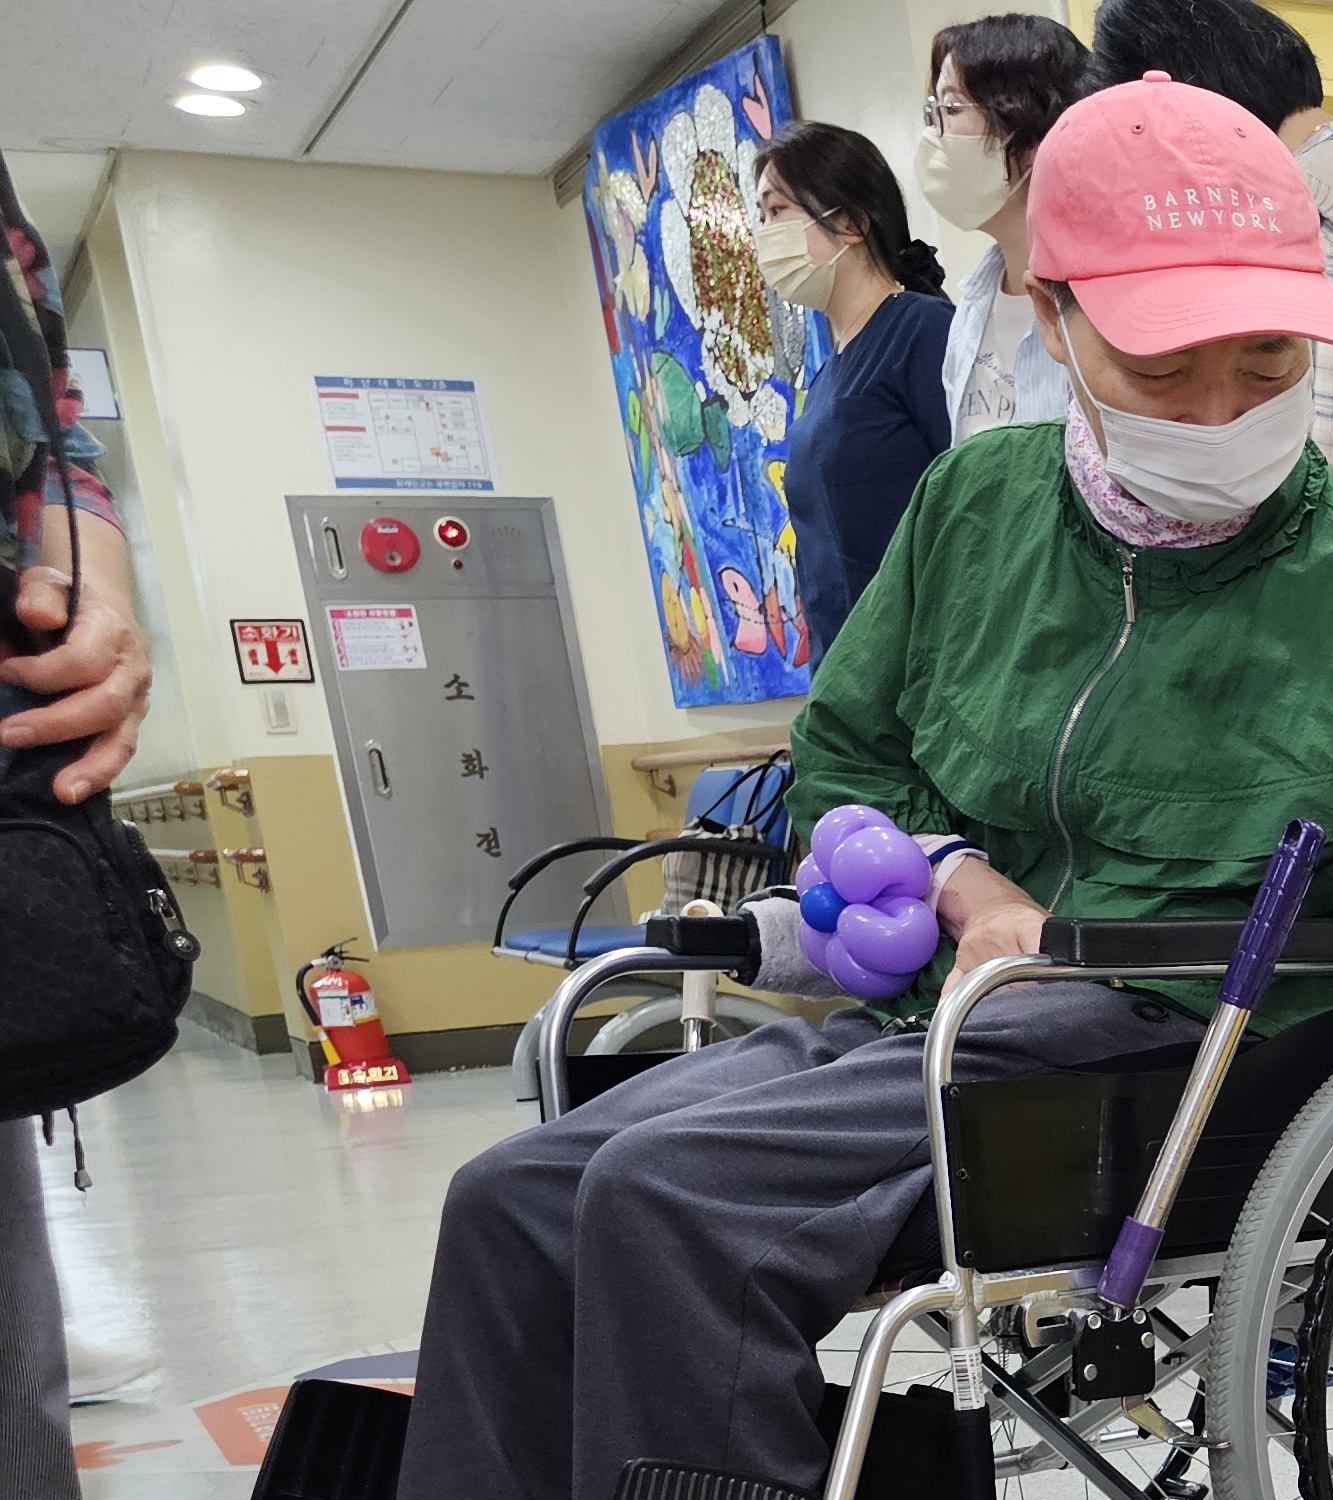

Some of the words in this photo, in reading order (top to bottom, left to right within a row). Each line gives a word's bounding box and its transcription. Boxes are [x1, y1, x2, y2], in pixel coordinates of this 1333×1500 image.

[1143, 186, 1274, 211] BARNEYS
[240, 625, 298, 643] 소화기
[443, 671, 503, 860] 소화전
